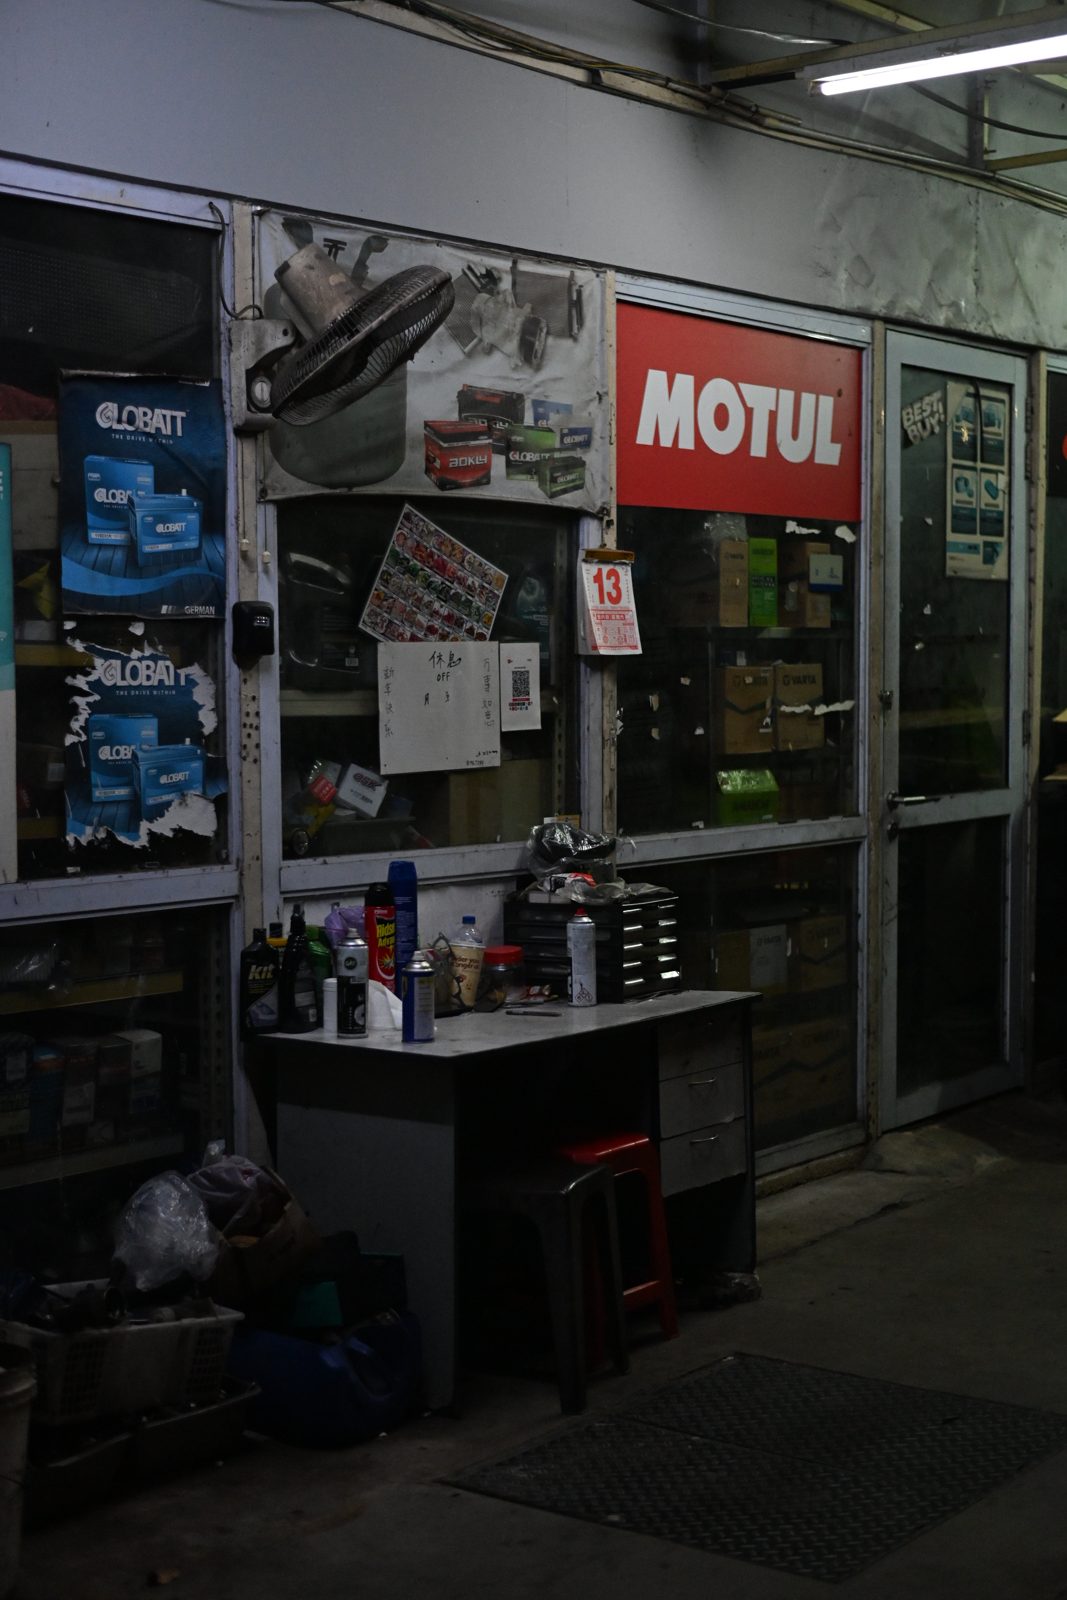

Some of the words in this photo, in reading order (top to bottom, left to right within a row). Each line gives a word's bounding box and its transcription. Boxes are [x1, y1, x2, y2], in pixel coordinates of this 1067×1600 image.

[902, 390, 942, 425] BEST
[95, 401, 188, 437] GLOBATT
[635, 368, 842, 467] MOTUL
[155, 522, 187, 534] GLOBATT
[593, 568, 622, 605] 13
[184, 605, 215, 615] GERMAN
[428, 650, 462, 669] 休息
[436, 672, 450, 682] OFF
[159, 772, 190, 784] GLOBATT
